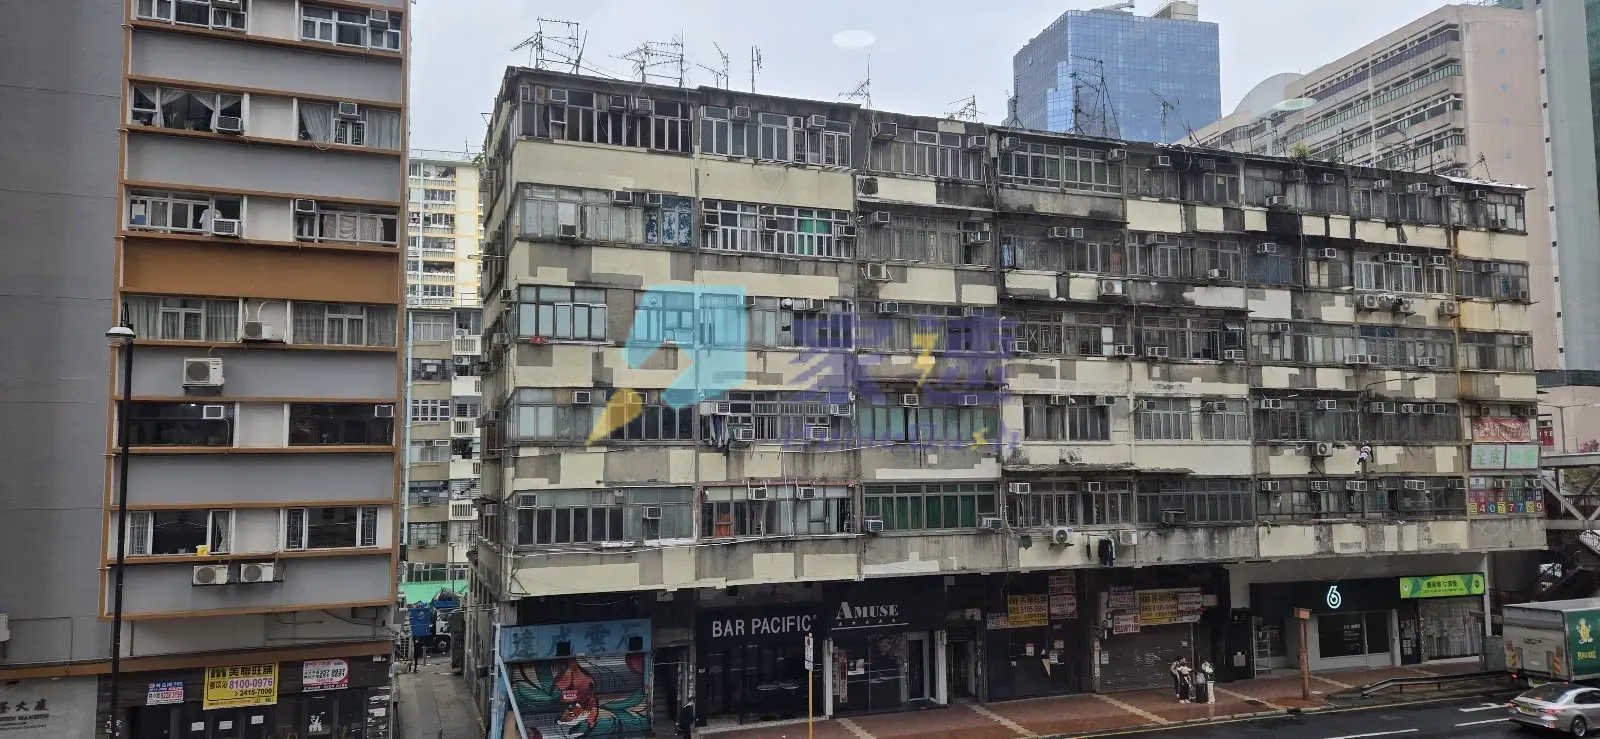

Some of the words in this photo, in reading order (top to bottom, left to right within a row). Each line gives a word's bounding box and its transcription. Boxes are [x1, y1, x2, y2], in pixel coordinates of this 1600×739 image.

[1326, 585, 1342, 609] 6
[836, 602, 899, 620] AMUSE
[712, 620, 745, 638] BAR
[751, 615, 812, 635] PACIFIC
[229, 678, 273, 689] 8100-0976
[18, 713, 50, 721] MANSION
